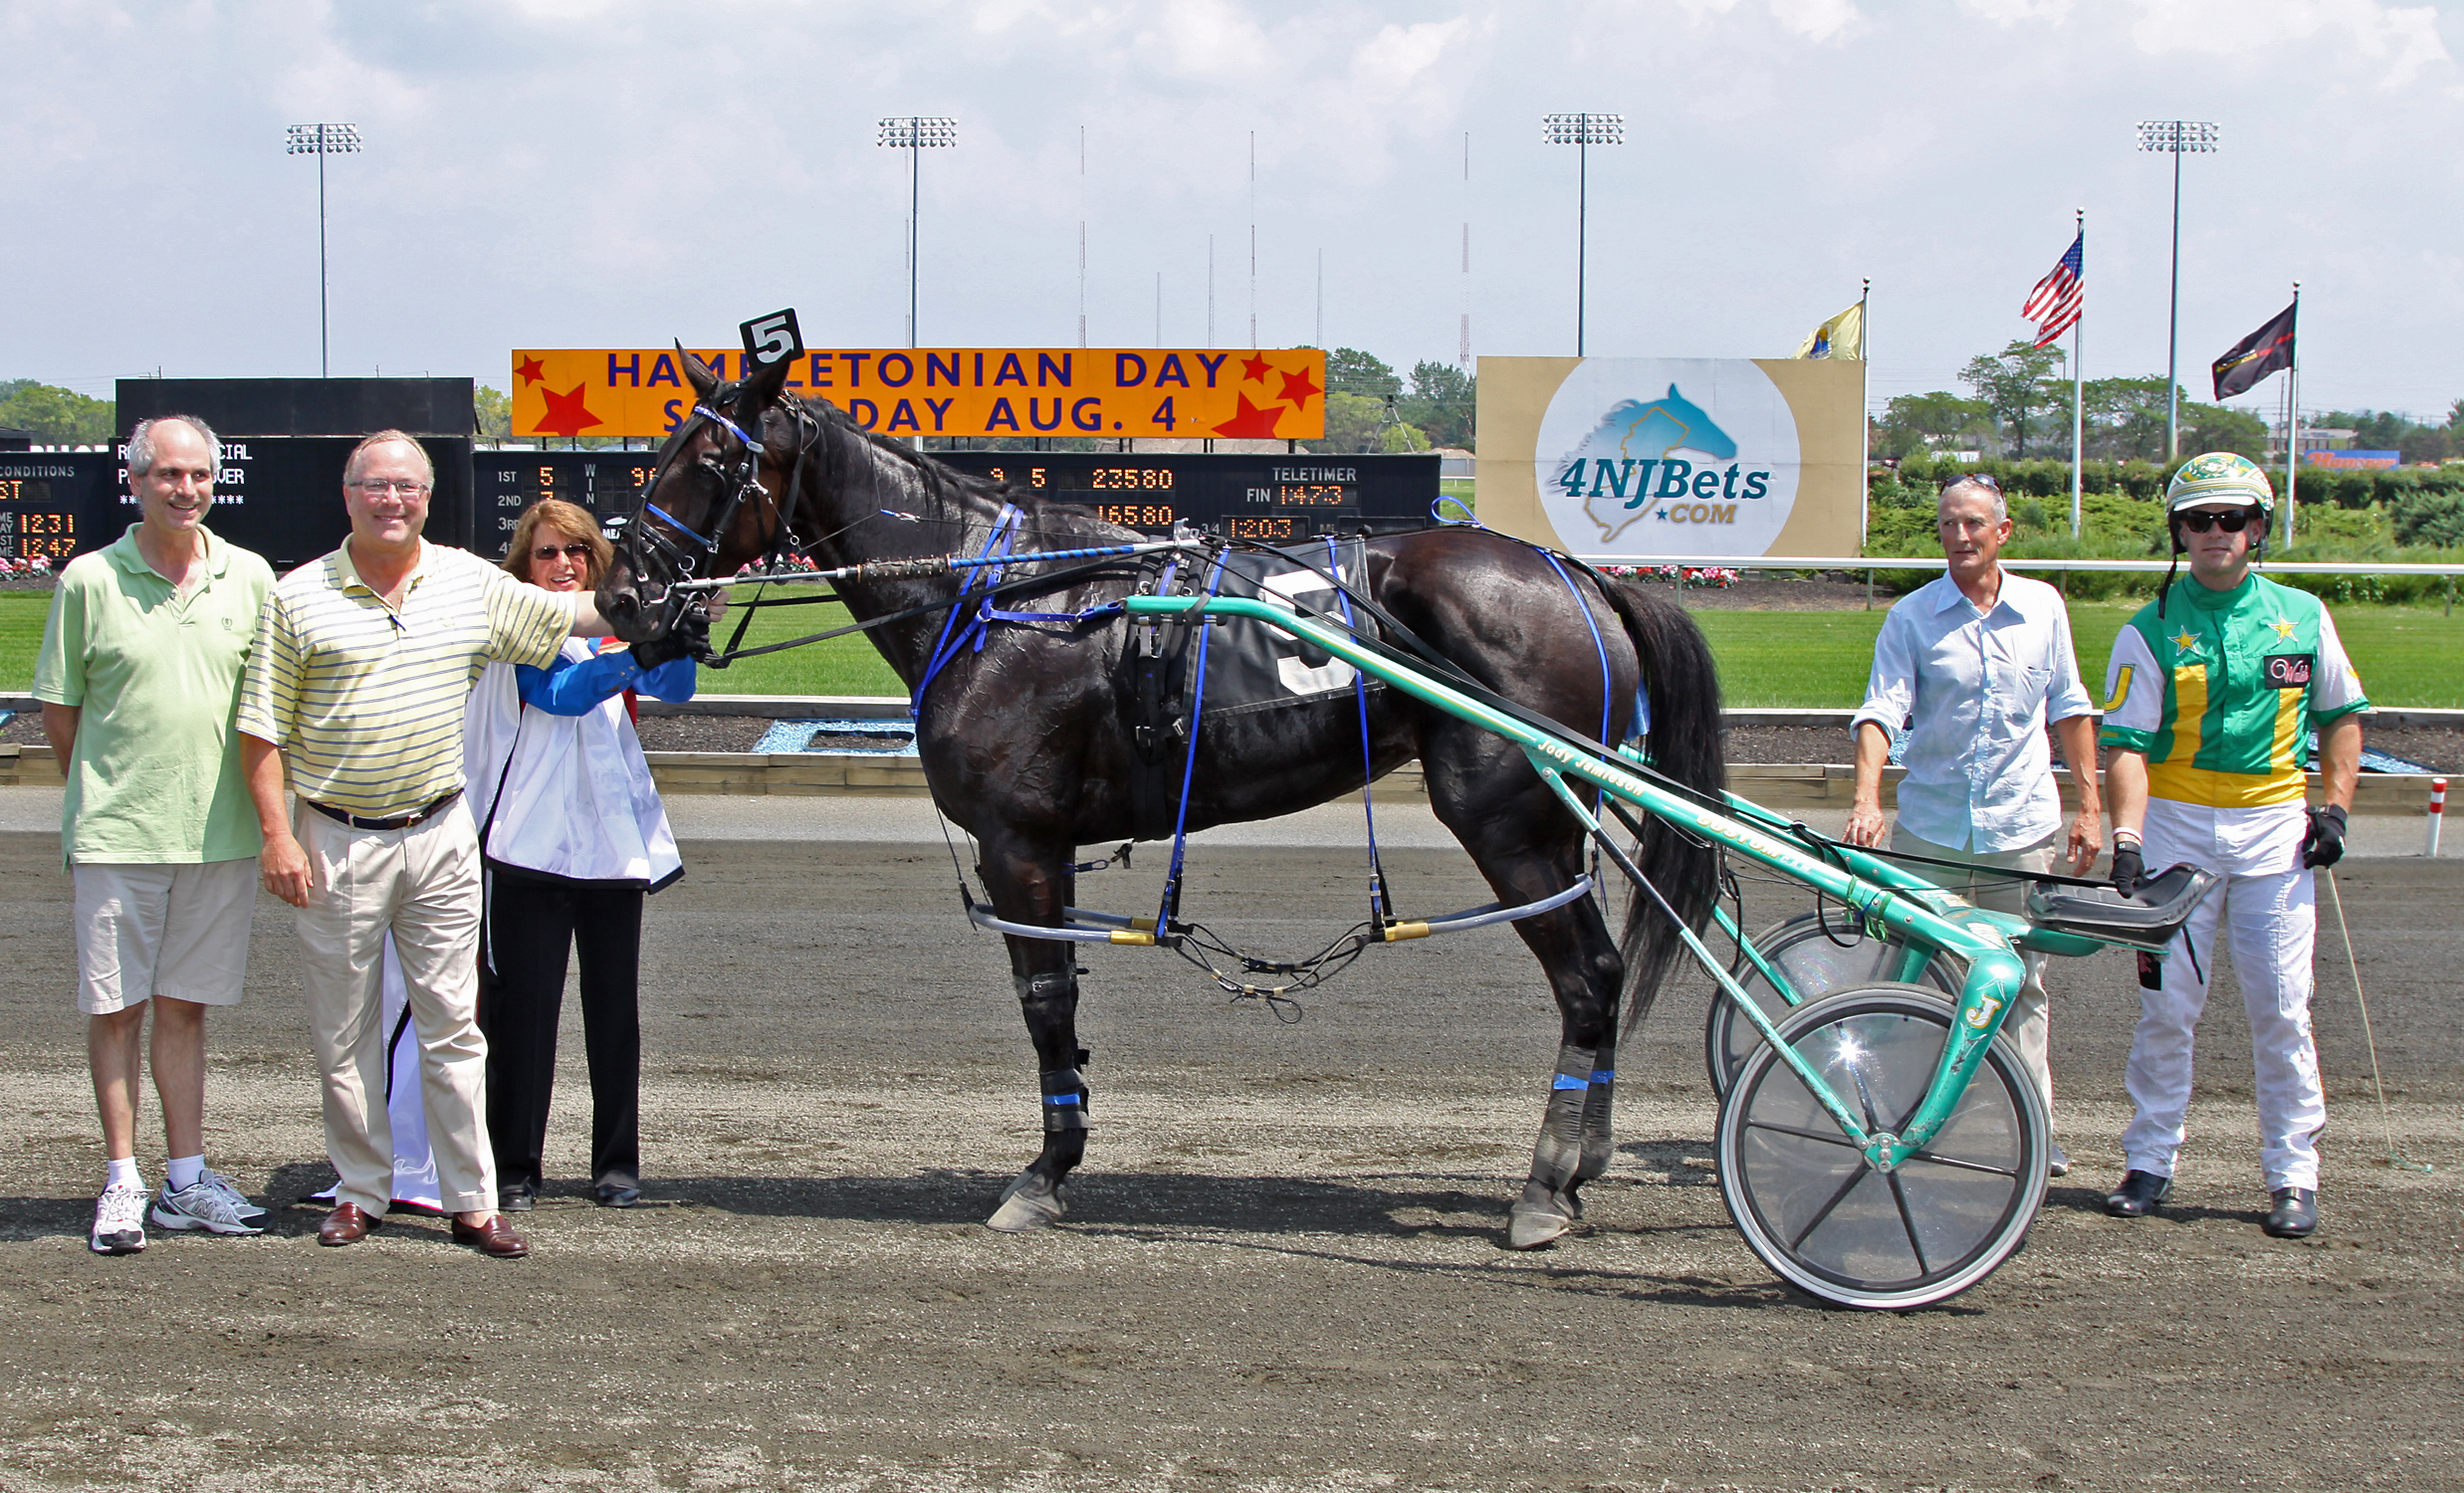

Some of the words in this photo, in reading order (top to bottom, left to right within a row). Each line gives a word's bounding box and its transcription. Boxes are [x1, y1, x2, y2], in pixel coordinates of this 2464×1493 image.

[751, 315, 794, 364] 5
[1115, 353, 1229, 388] DAY
[984, 397, 1123, 431] AUG.
[1152, 396, 1176, 431] 4
[2307, 452, 2396, 470] Hanover
[498, 472, 517, 482] 1ST
[540, 467, 554, 486] 5
[1031, 468, 1045, 488] 5
[1093, 469, 1173, 489] 23580
[1272, 468, 1356, 482] TELETIMER
[1560, 457, 1769, 510] 4NJBets
[498, 496, 522, 507] 2ND
[1246, 488, 1270, 503] FIN
[21, 514, 74, 533] 1231
[1097, 505, 1173, 526] 16580
[22, 538, 76, 556] 1247
[1538, 740, 1575, 764] Jody
[1575, 757, 1645, 797] Jamieson
[1696, 814, 1781, 859] CUSTOM
[1965, 994, 2002, 1029] J
